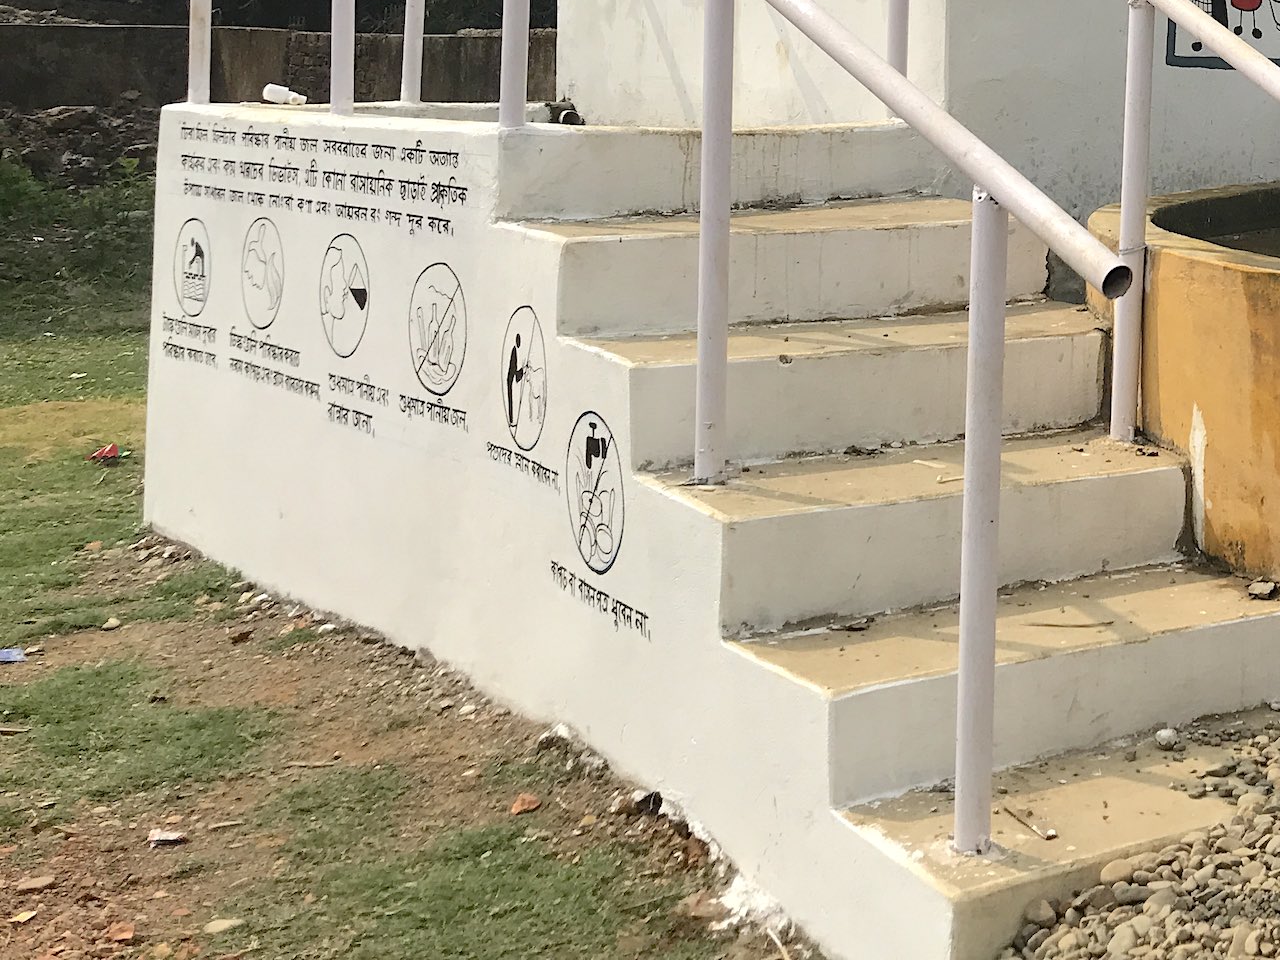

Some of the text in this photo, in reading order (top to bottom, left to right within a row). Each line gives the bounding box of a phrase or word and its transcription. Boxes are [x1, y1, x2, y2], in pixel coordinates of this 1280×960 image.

[300, 137, 318, 153] জল
[372, 144, 396, 161] জন্য
[401, 139, 426, 165] একটি
